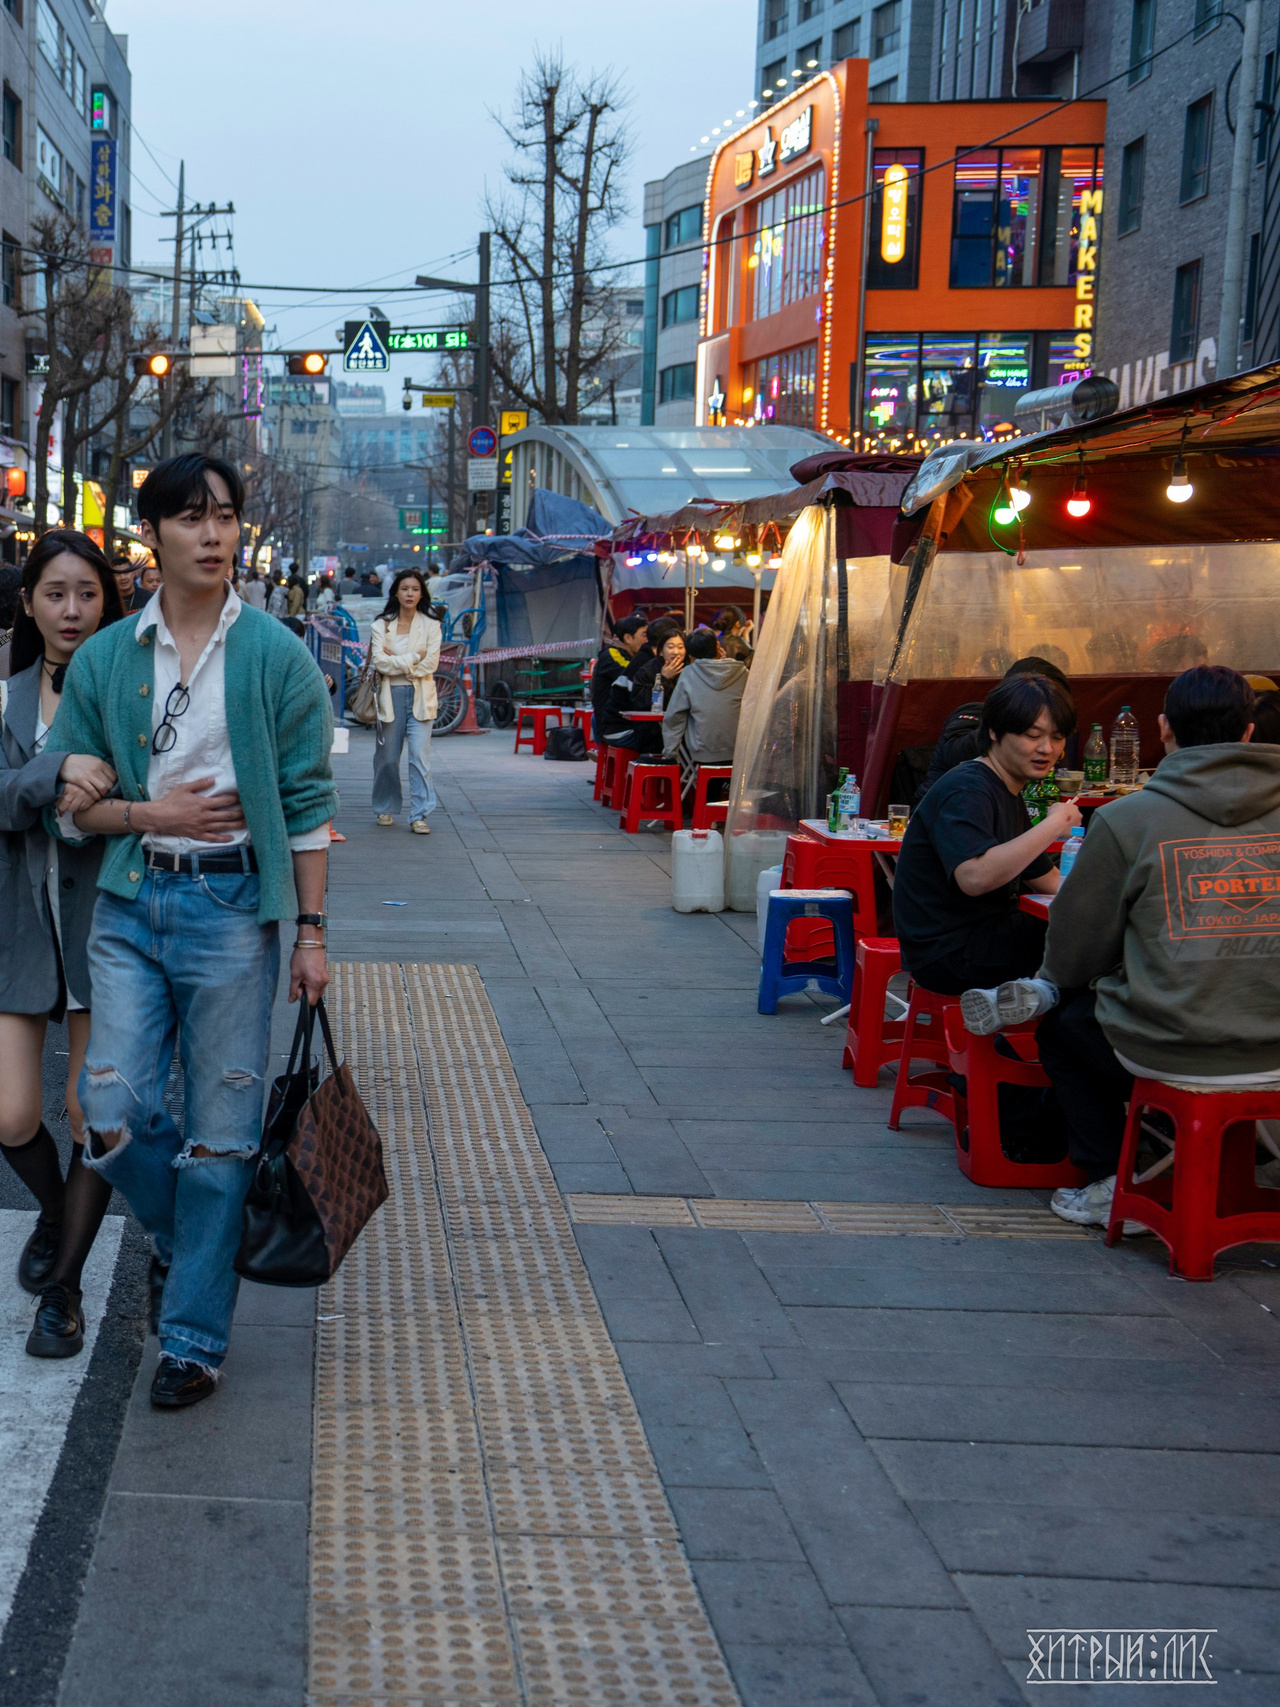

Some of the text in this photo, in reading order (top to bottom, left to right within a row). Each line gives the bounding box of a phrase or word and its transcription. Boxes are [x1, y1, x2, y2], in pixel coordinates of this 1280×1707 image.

[1073, 189, 1104, 358] MAKERS
[1183, 848, 1233, 859] YOSHIDA
[1235, 848, 1244, 857] &
